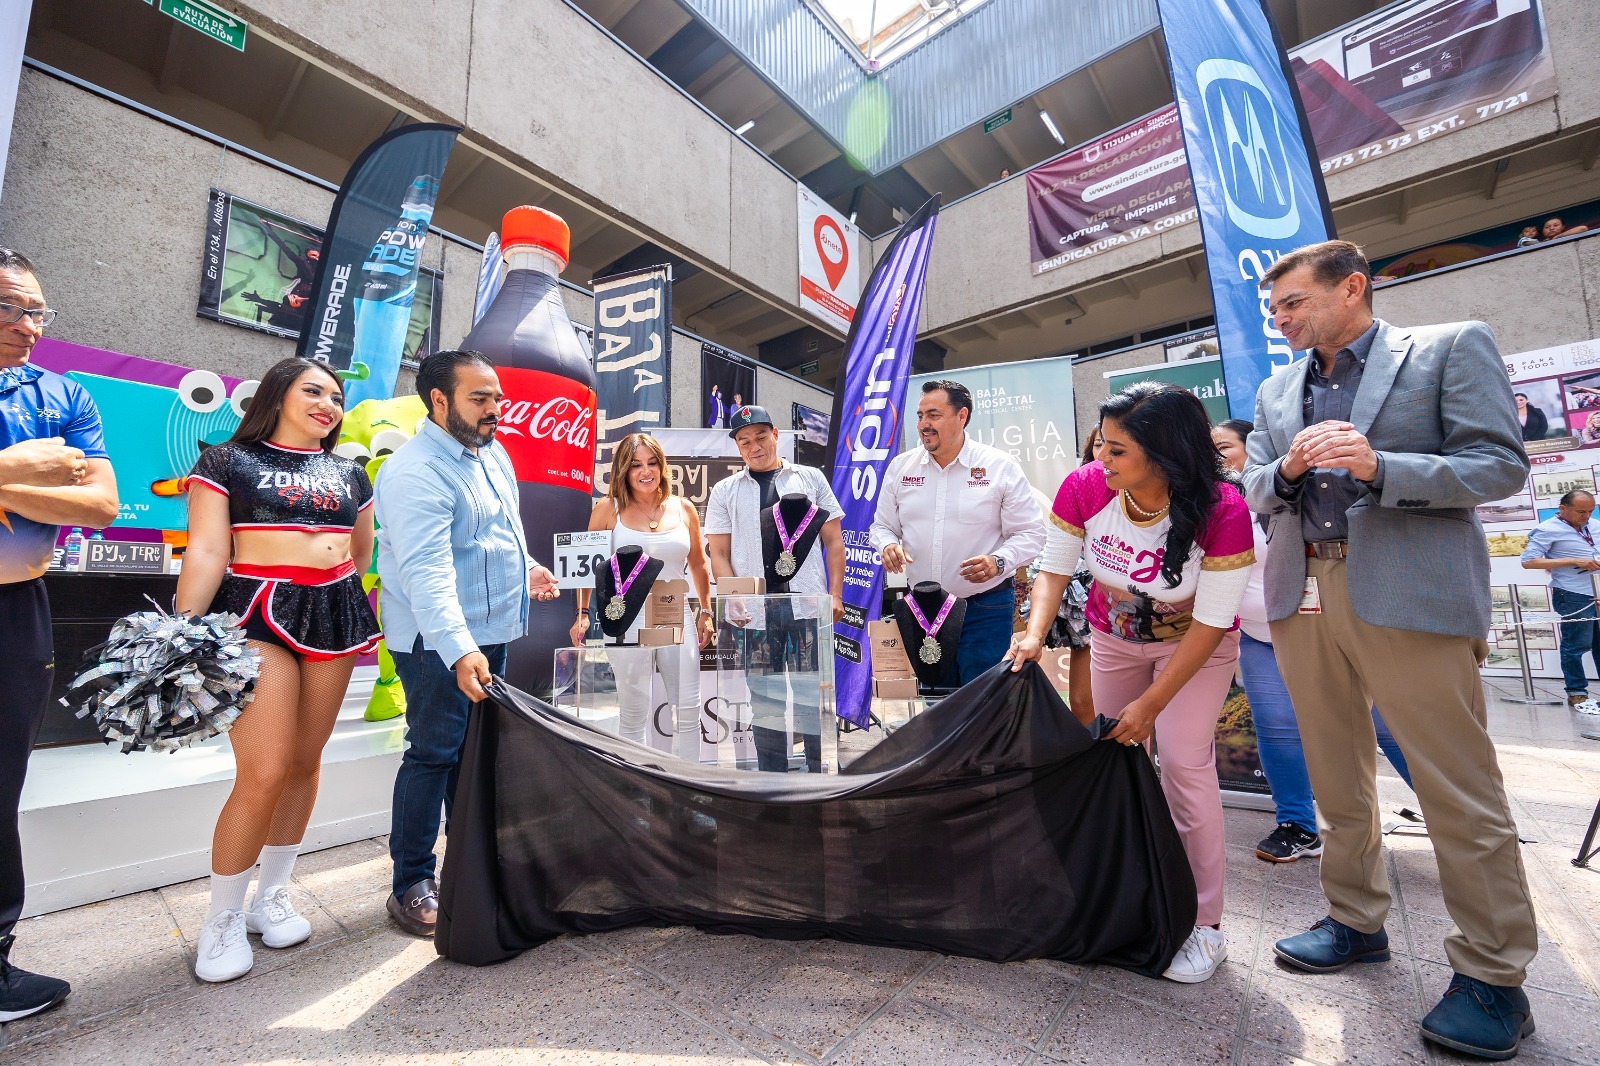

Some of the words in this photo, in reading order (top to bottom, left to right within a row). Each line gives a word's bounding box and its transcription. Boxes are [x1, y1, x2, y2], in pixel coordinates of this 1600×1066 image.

[173, 7, 233, 42] EVACUACIÓN
[184, 6, 210, 24] RUTA
[212, 20, 224, 30] DE
[1104, 128, 1144, 150] TIJUANA
[1320, 153, 1354, 174] 973
[1358, 144, 1383, 160] 72
[1386, 134, 1413, 151] 73
[1416, 114, 1466, 141] EXT.
[1476, 91, 1529, 120] 7721
[1036, 183, 1060, 200] HAZ
[1061, 176, 1078, 188] TU
[1079, 135, 1172, 181] DECLARACIÓN
[213, 191, 226, 227] Atisbos
[1058, 222, 1110, 245] CAPTURA
[1124, 195, 1178, 221] IMPRIME
[1085, 203, 1127, 225] VISITA
[210, 253, 218, 264] el
[1038, 234, 1128, 273] ¡SINDICATURA
[1130, 226, 1152, 240] VA
[208, 266, 218, 280] En
[1522, 356, 1554, 366] PARA
[1523, 362, 1555, 370] TODOS
[976, 387, 1006, 399] BAJA
[978, 394, 1036, 409] HOSPITAL
[1012, 404, 1032, 412] CENTER
[852, 347, 895, 502] spin
[256, 471, 352, 500] ZONKEY
[572, 469, 584, 482] 600
[1092, 543, 1130, 566] MARATÓN
[1108, 546, 1132, 559] MEDIO
[850, 566, 856, 575] y
[856, 567, 874, 578] recibe
[1096, 557, 1128, 576] TIJUANA
